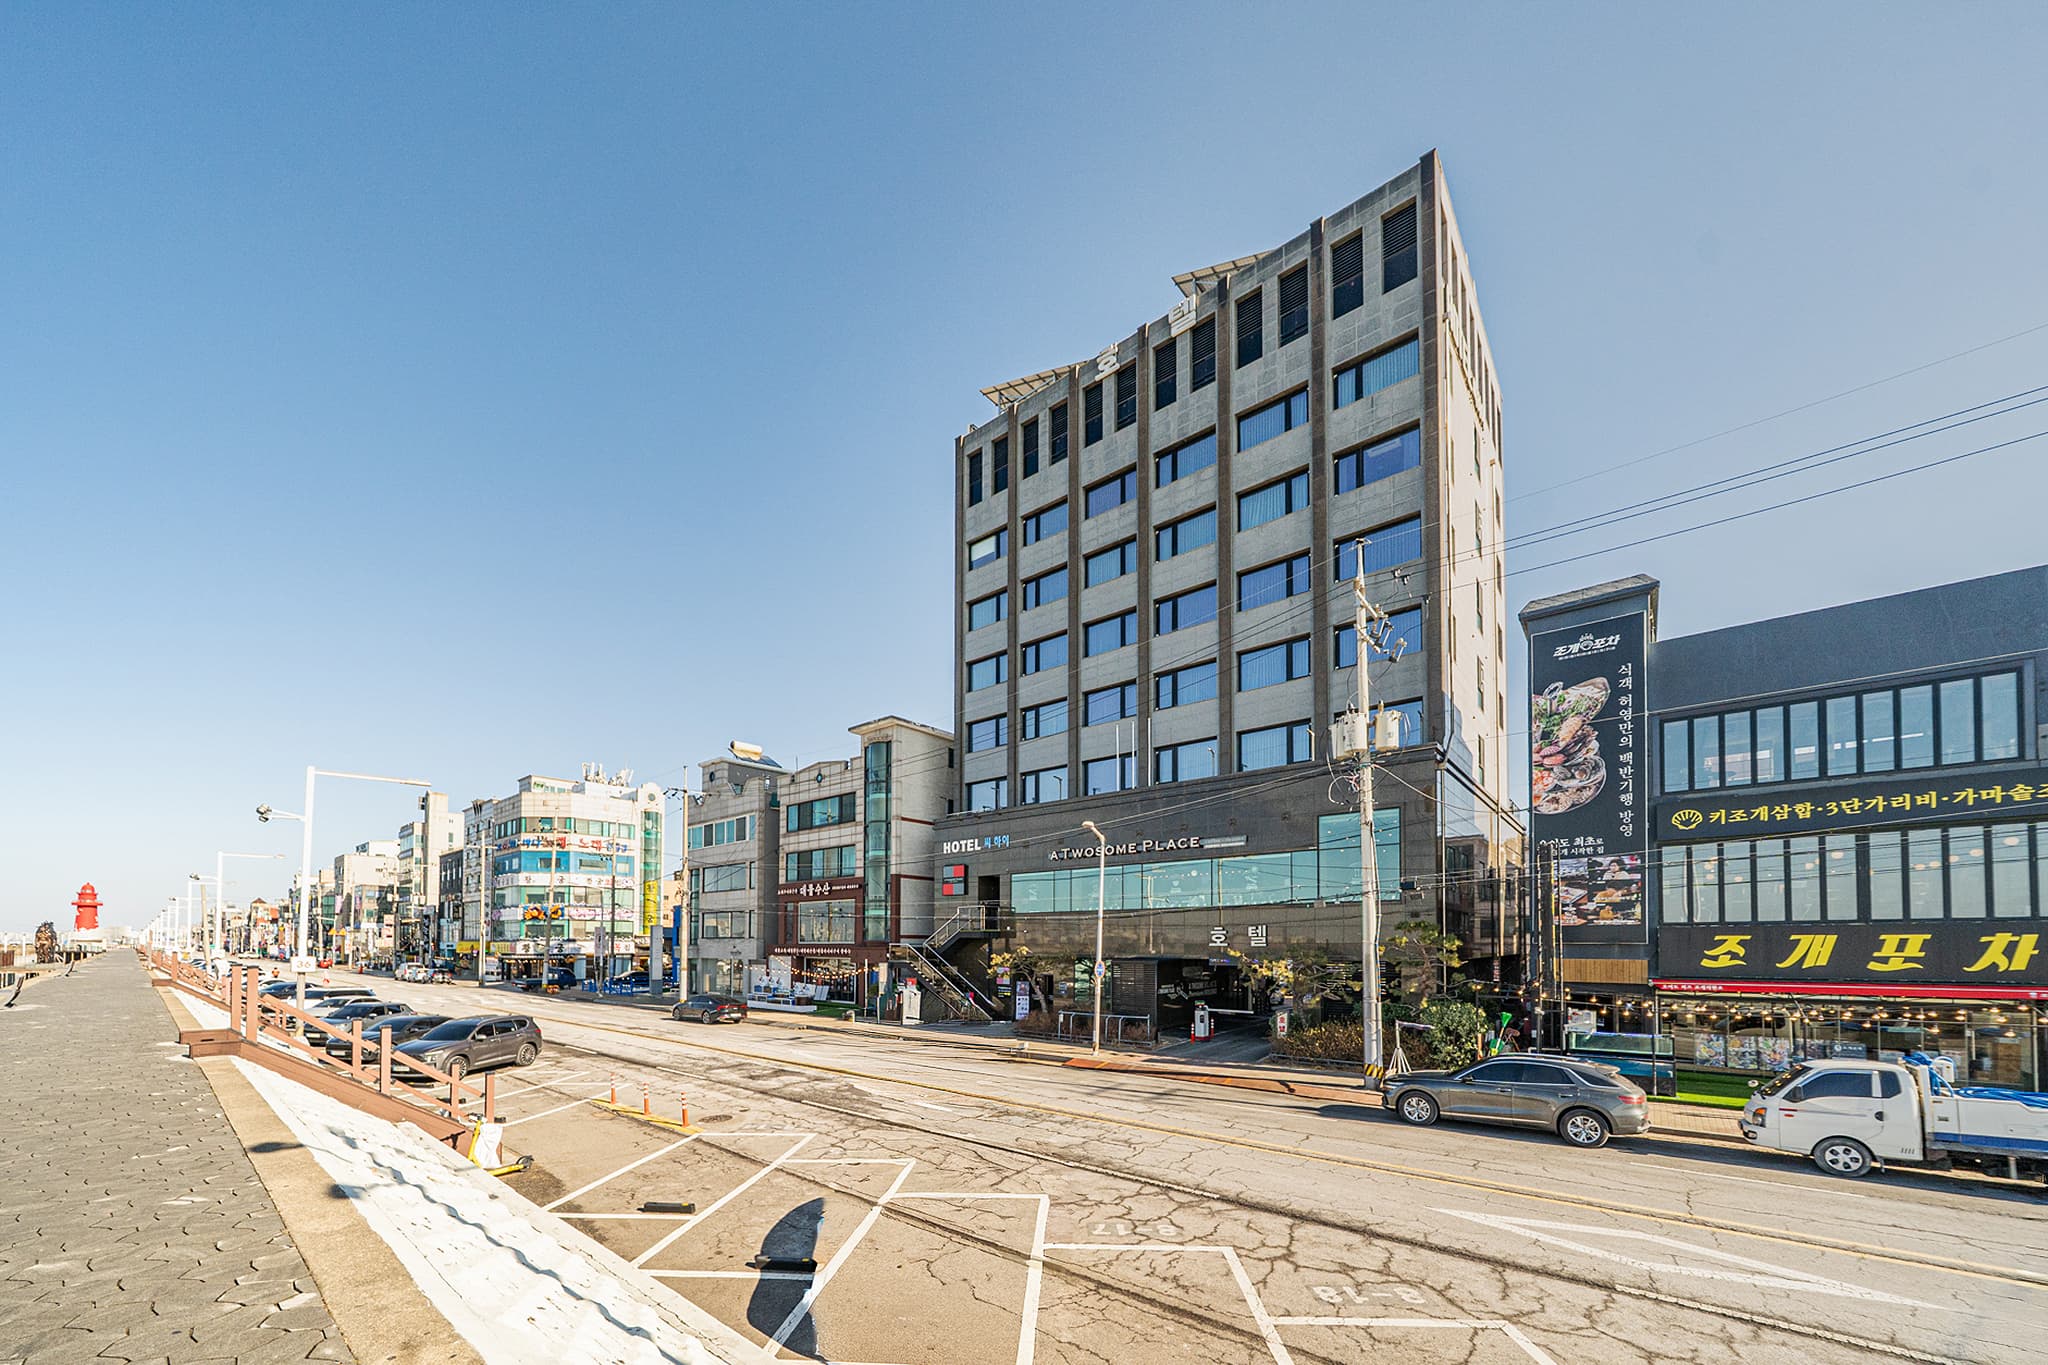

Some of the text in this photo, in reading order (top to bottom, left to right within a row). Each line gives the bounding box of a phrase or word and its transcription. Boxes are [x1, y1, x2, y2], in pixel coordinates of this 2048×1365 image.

[1618, 662, 1634, 837] 식객 허영만의 백반기행 방영
[943, 838, 982, 854] HOTEL
[1049, 850, 1059, 861] A
[1208, 924, 1268, 947] 호텔
[296, 960, 311, 969] 36
